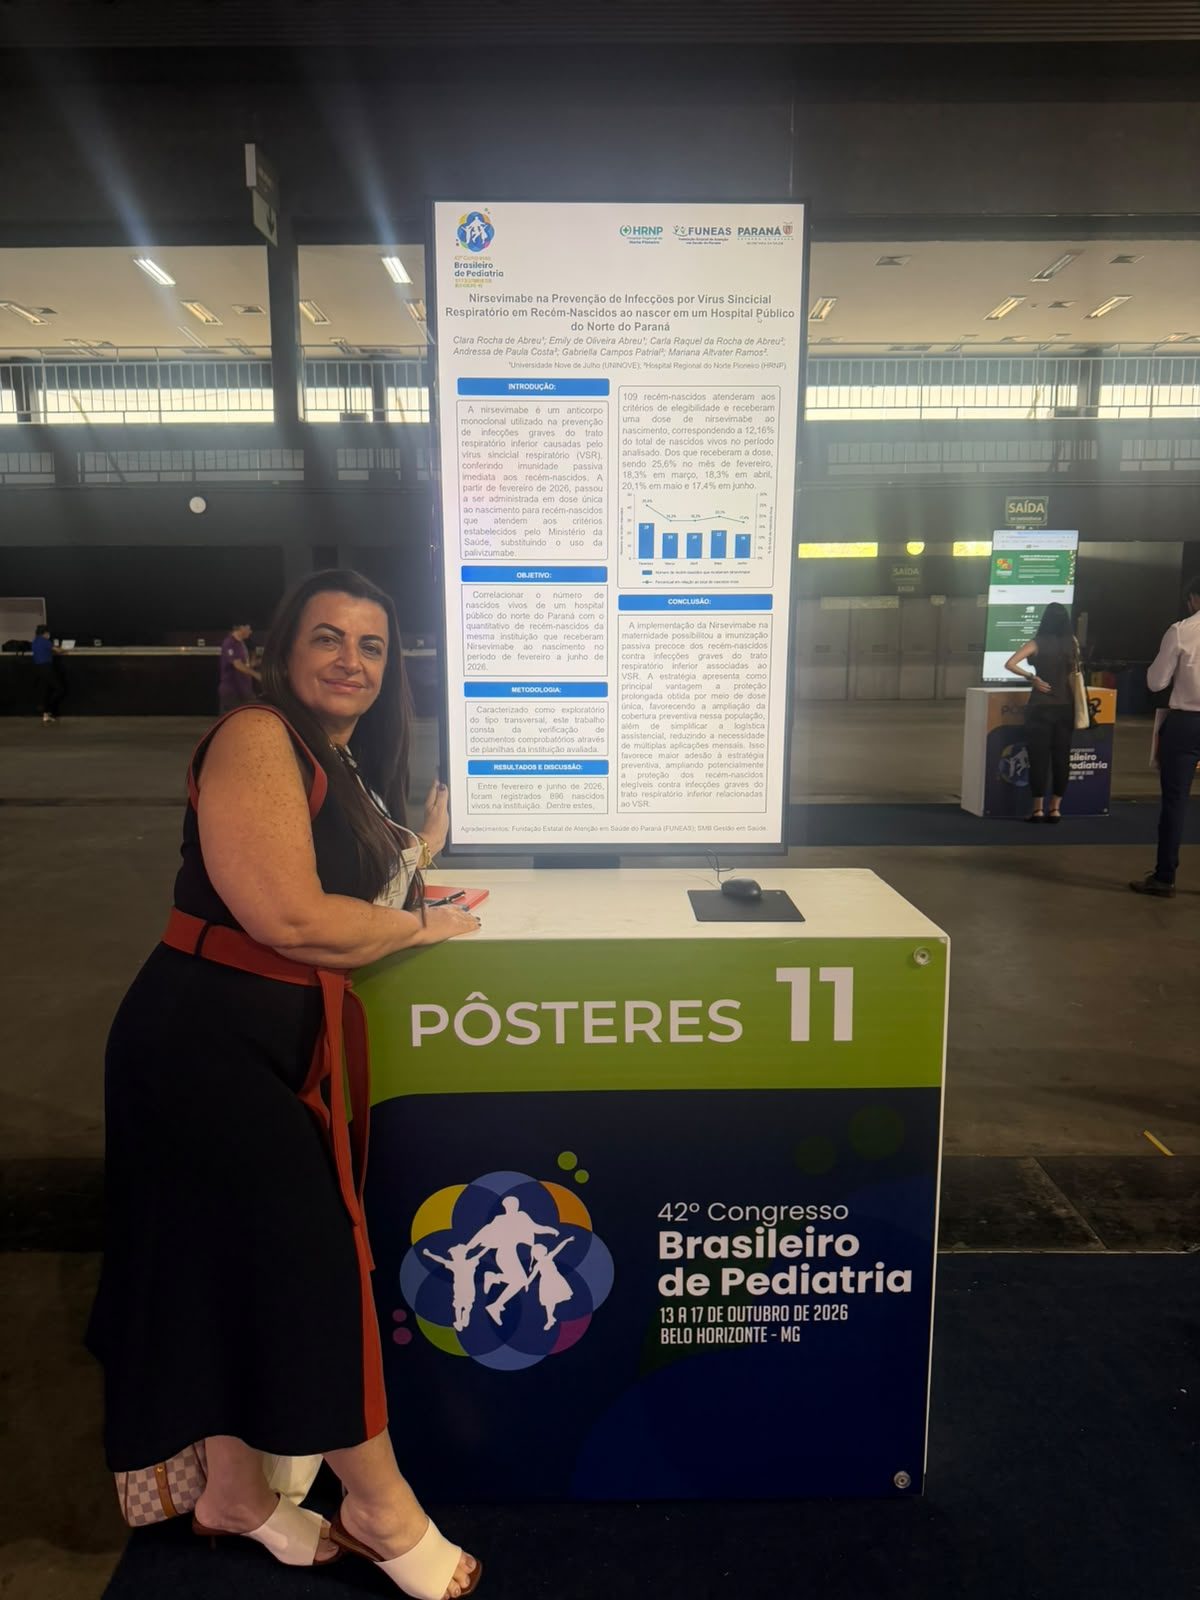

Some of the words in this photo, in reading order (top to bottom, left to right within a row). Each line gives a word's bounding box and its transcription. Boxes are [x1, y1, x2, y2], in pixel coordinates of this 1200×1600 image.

[634, 227, 663, 235] HRNP
[688, 227, 732, 235] FUNEAS
[738, 226, 781, 235] PARANÁ
[454, 261, 493, 269] Brasileiro
[469, 294, 533, 304] Nirsevimabe
[536, 296, 549, 304] na
[552, 294, 607, 307] Prevenção
[609, 294, 622, 304] de
[625, 294, 674, 307] Infecções
[677, 297, 695, 307] por
[697, 294, 725, 304] Vírus
[727, 295, 771, 304] Sincicial
[446, 308, 509, 320] Respiratório
[531, 308, 617, 318] Recém-Nascidos
[620, 310, 633, 318] ao
[636, 310, 671, 318] nascer
[673, 310, 689, 318] em
[692, 310, 707, 318] um
[711, 308, 753, 321] Hospital
[756, 308, 795, 318] Público
[570, 322, 584, 331] do
[587, 322, 615, 331] Norte
[618, 322, 632, 331] do
[634, 322, 670, 331] Paraná
[453, 336, 474, 345] Clara
[477, 336, 503, 345] Rocha
[549, 336, 571, 347] Emily
[586, 336, 616, 345] Oliveira
[650, 336, 671, 345] Carla
[673, 336, 703, 347] Raquel
[716, 336, 742, 345] Rocha
[453, 347, 491, 356] Andressa
[505, 347, 529, 356] Paula
[562, 347, 597, 356] Gabriella
[600, 347, 633, 358] Campos
[668, 347, 700, 356] Mariana
[702, 347, 733, 356] Altvater
[509, 383, 557, 391] INTRODUÇÃO:
[624, 392, 638, 400] 109
[644, 392, 706, 401] recém-nascidos
[712, 392, 755, 401] atenderam
[467, 406, 474, 414] A
[480, 406, 529, 414] nirsevimabe
[566, 406, 604, 416] anticorpo
[460, 417, 506, 425] monoclonal
[510, 417, 543, 425] utilizado
[561, 417, 604, 427] prevenção
[651, 415, 672, 423] dose
[705, 415, 753, 423] nirsevimabe
[481, 428, 519, 438] infecções
[528, 430, 556, 438] graves
[461, 439, 506, 449] respiratório
[511, 439, 538, 447] inferior
[543, 439, 581, 447] causadas
[586, 439, 604, 449] pelo
[635, 437, 653, 445] total
[669, 437, 704, 445] nascidos
[707, 437, 728, 445] vivos
[744, 437, 775, 447] período
[461, 450, 481, 458] vírus
[488, 450, 519, 458] sincicial
[525, 450, 570, 460] respiratório
[622, 459, 647, 467] sendo
[652, 459, 677, 469] 25,6%
[698, 459, 715, 467] mês
[1009, 500, 1045, 513] SAÍDA
[466, 611, 493, 621] público
[548, 611, 575, 619] Paraná
[647, 671, 654, 679] A
[659, 671, 696, 681] estratégia
[702, 671, 740, 680] apresenta
[484, 716, 499, 726] tipo
[552, 716, 569, 724] este
[574, 715, 605, 724] trabalho
[478, 782, 498, 790] Entre
[501, 782, 534, 790] fevereiro
[546, 782, 567, 792] junho
[411, 991, 743, 1047] PÔSTERES
[776, 966, 854, 1042] 11
[657, 1202, 700, 1222] 42º
[707, 1202, 849, 1227] Congresso
[658, 1225, 860, 1260] Brasileiro
[658, 1267, 711, 1297] de
[721, 1261, 913, 1296] Pediatria
[660, 1306, 674, 1324] 13
[678, 1306, 687, 1323] A
[690, 1306, 704, 1323] 17
[707, 1306, 724, 1323] DE
[727, 1304, 790, 1322] OUTUBRO
[793, 1304, 810, 1322] DE
[813, 1303, 849, 1321] 2026
[660, 1327, 693, 1345] BELO
[696, 1326, 768, 1345] HORIZONTE
[781, 1325, 801, 1343] MG
